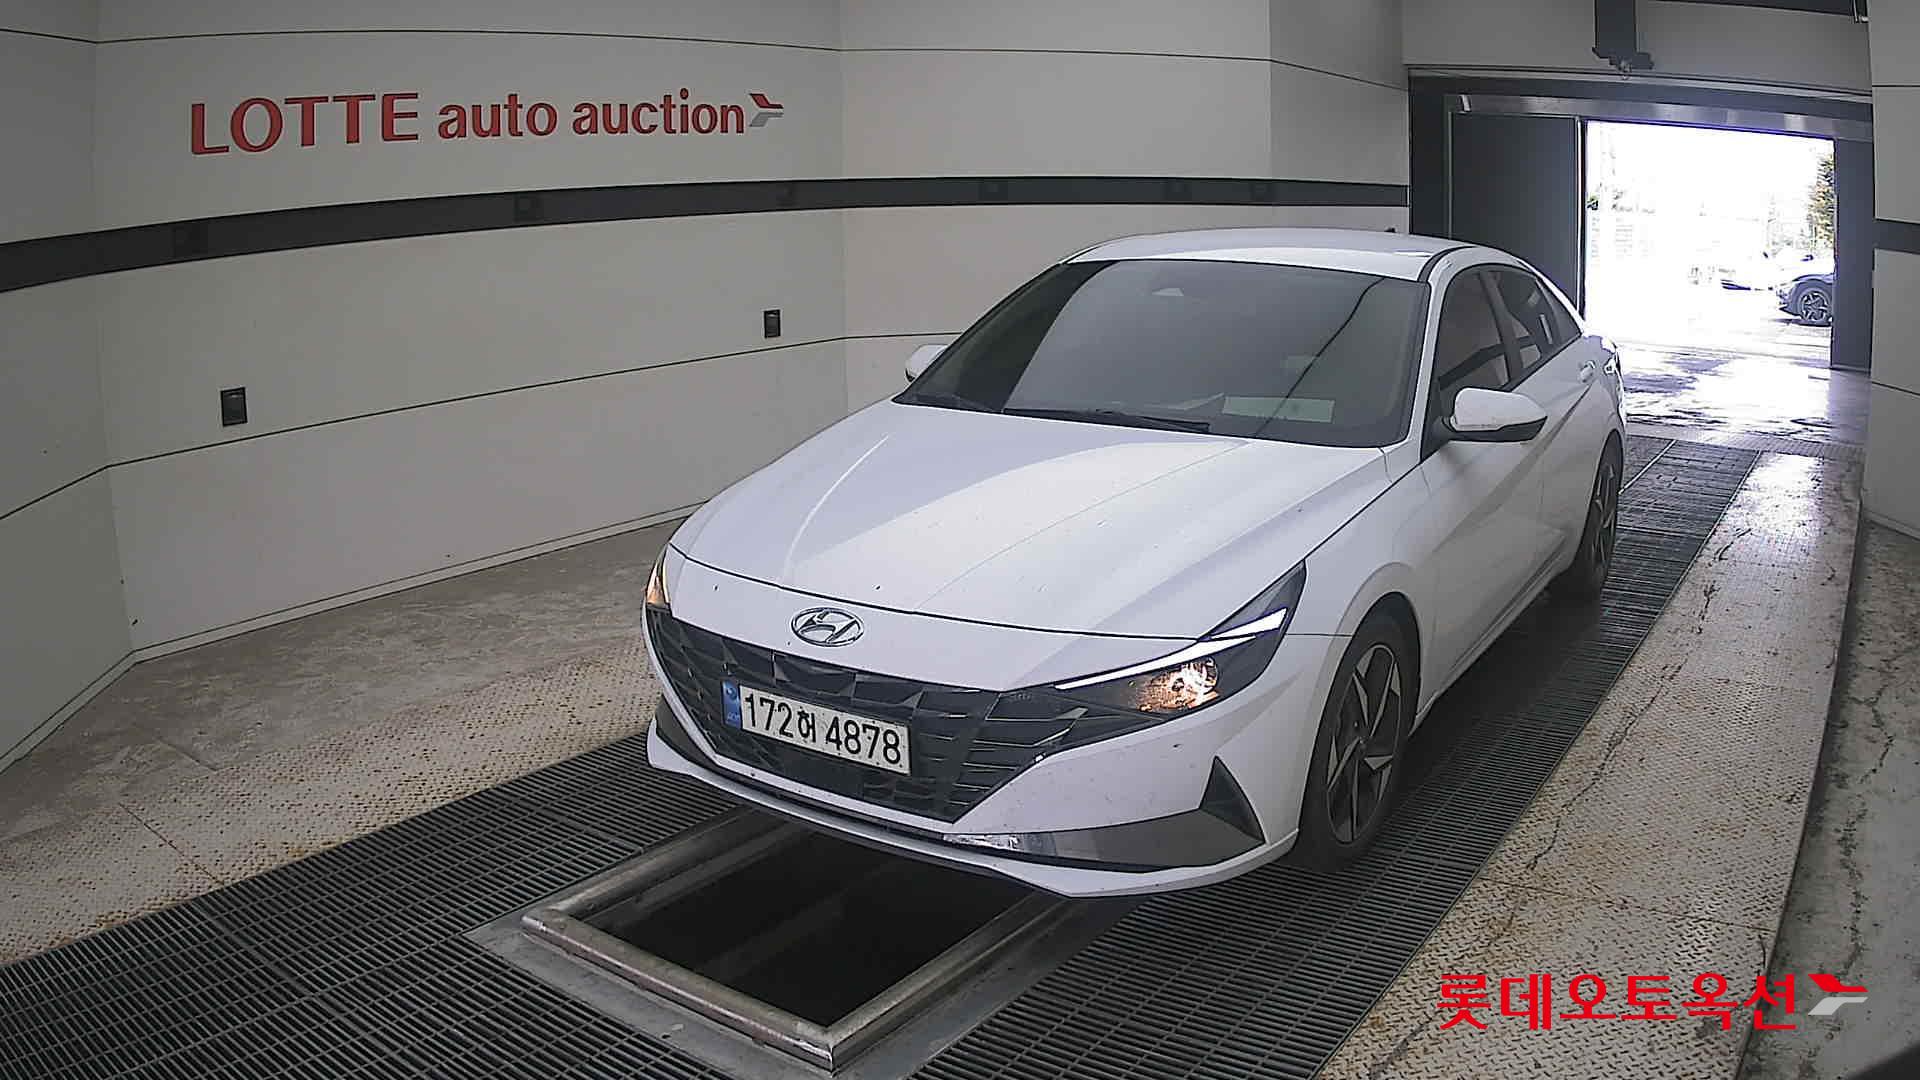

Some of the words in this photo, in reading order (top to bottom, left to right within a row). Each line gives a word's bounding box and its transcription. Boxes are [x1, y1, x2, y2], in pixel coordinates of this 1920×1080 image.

[191, 93, 419, 155] LOTTE
[437, 95, 558, 139] auto
[572, 88, 745, 135] auction
[825, 716, 901, 764] 4878
